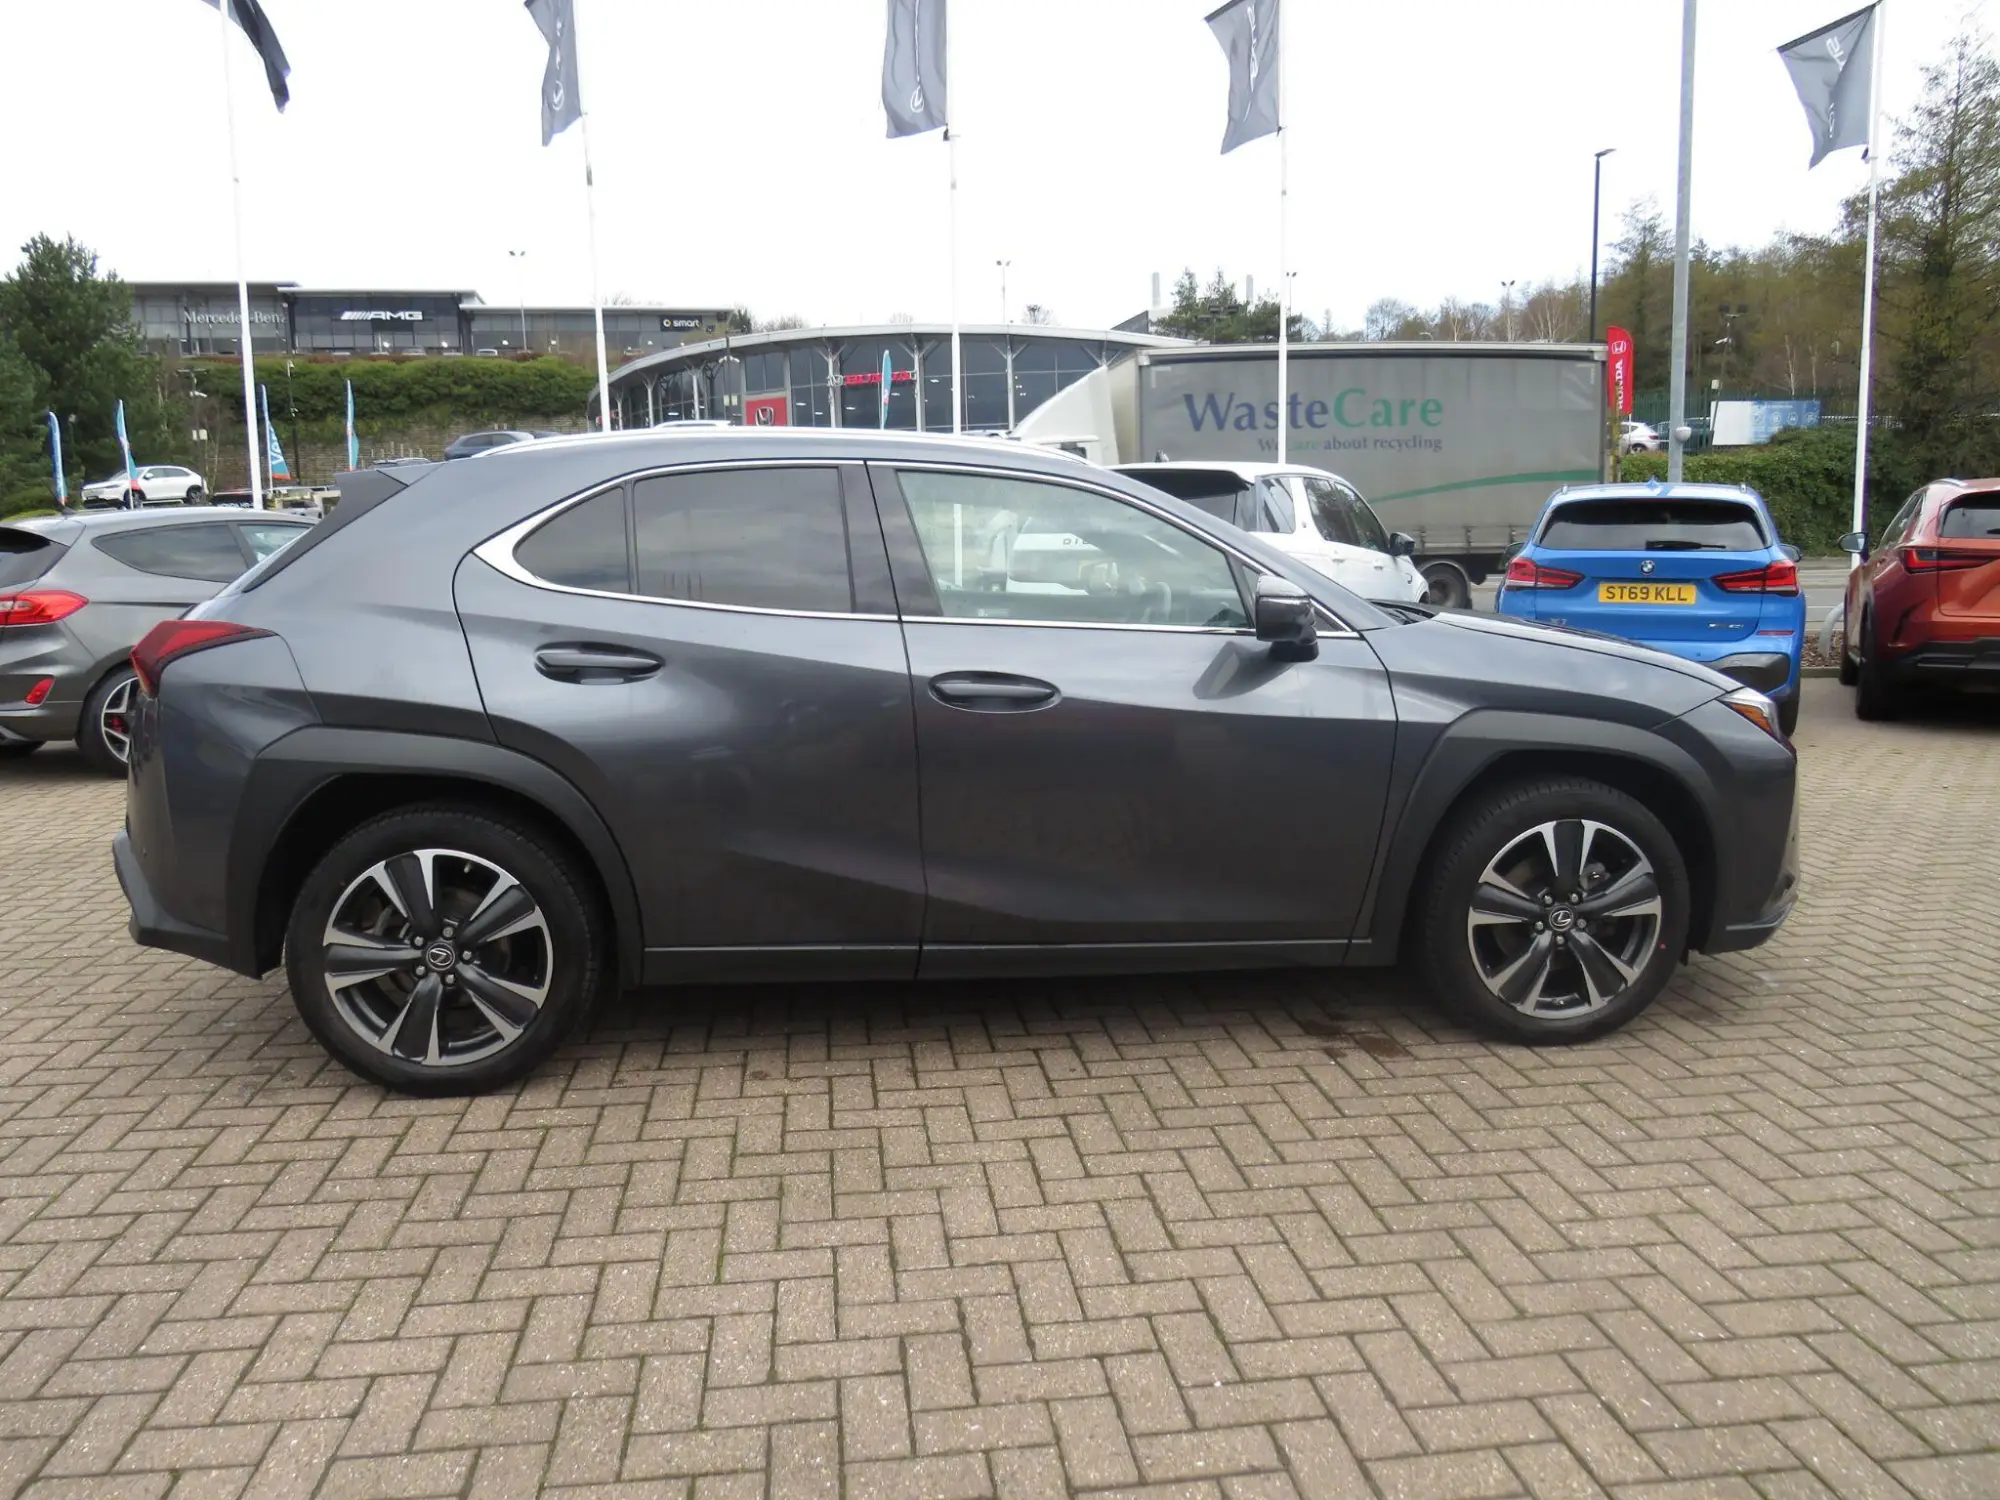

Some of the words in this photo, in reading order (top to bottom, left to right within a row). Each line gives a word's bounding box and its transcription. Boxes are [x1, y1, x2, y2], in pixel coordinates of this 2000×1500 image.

[366, 310, 423, 321] AMG
[672, 319, 700, 328] smart
[1183, 388, 1443, 431] WasteCare
[1257, 438, 1280, 452] W
[1287, 439, 1319, 451] are
[1323, 435, 1368, 450] about
[1373, 434, 1443, 453] recycling
[1605, 585, 1650, 601] ST69
[1654, 586, 1688, 602] KLL
